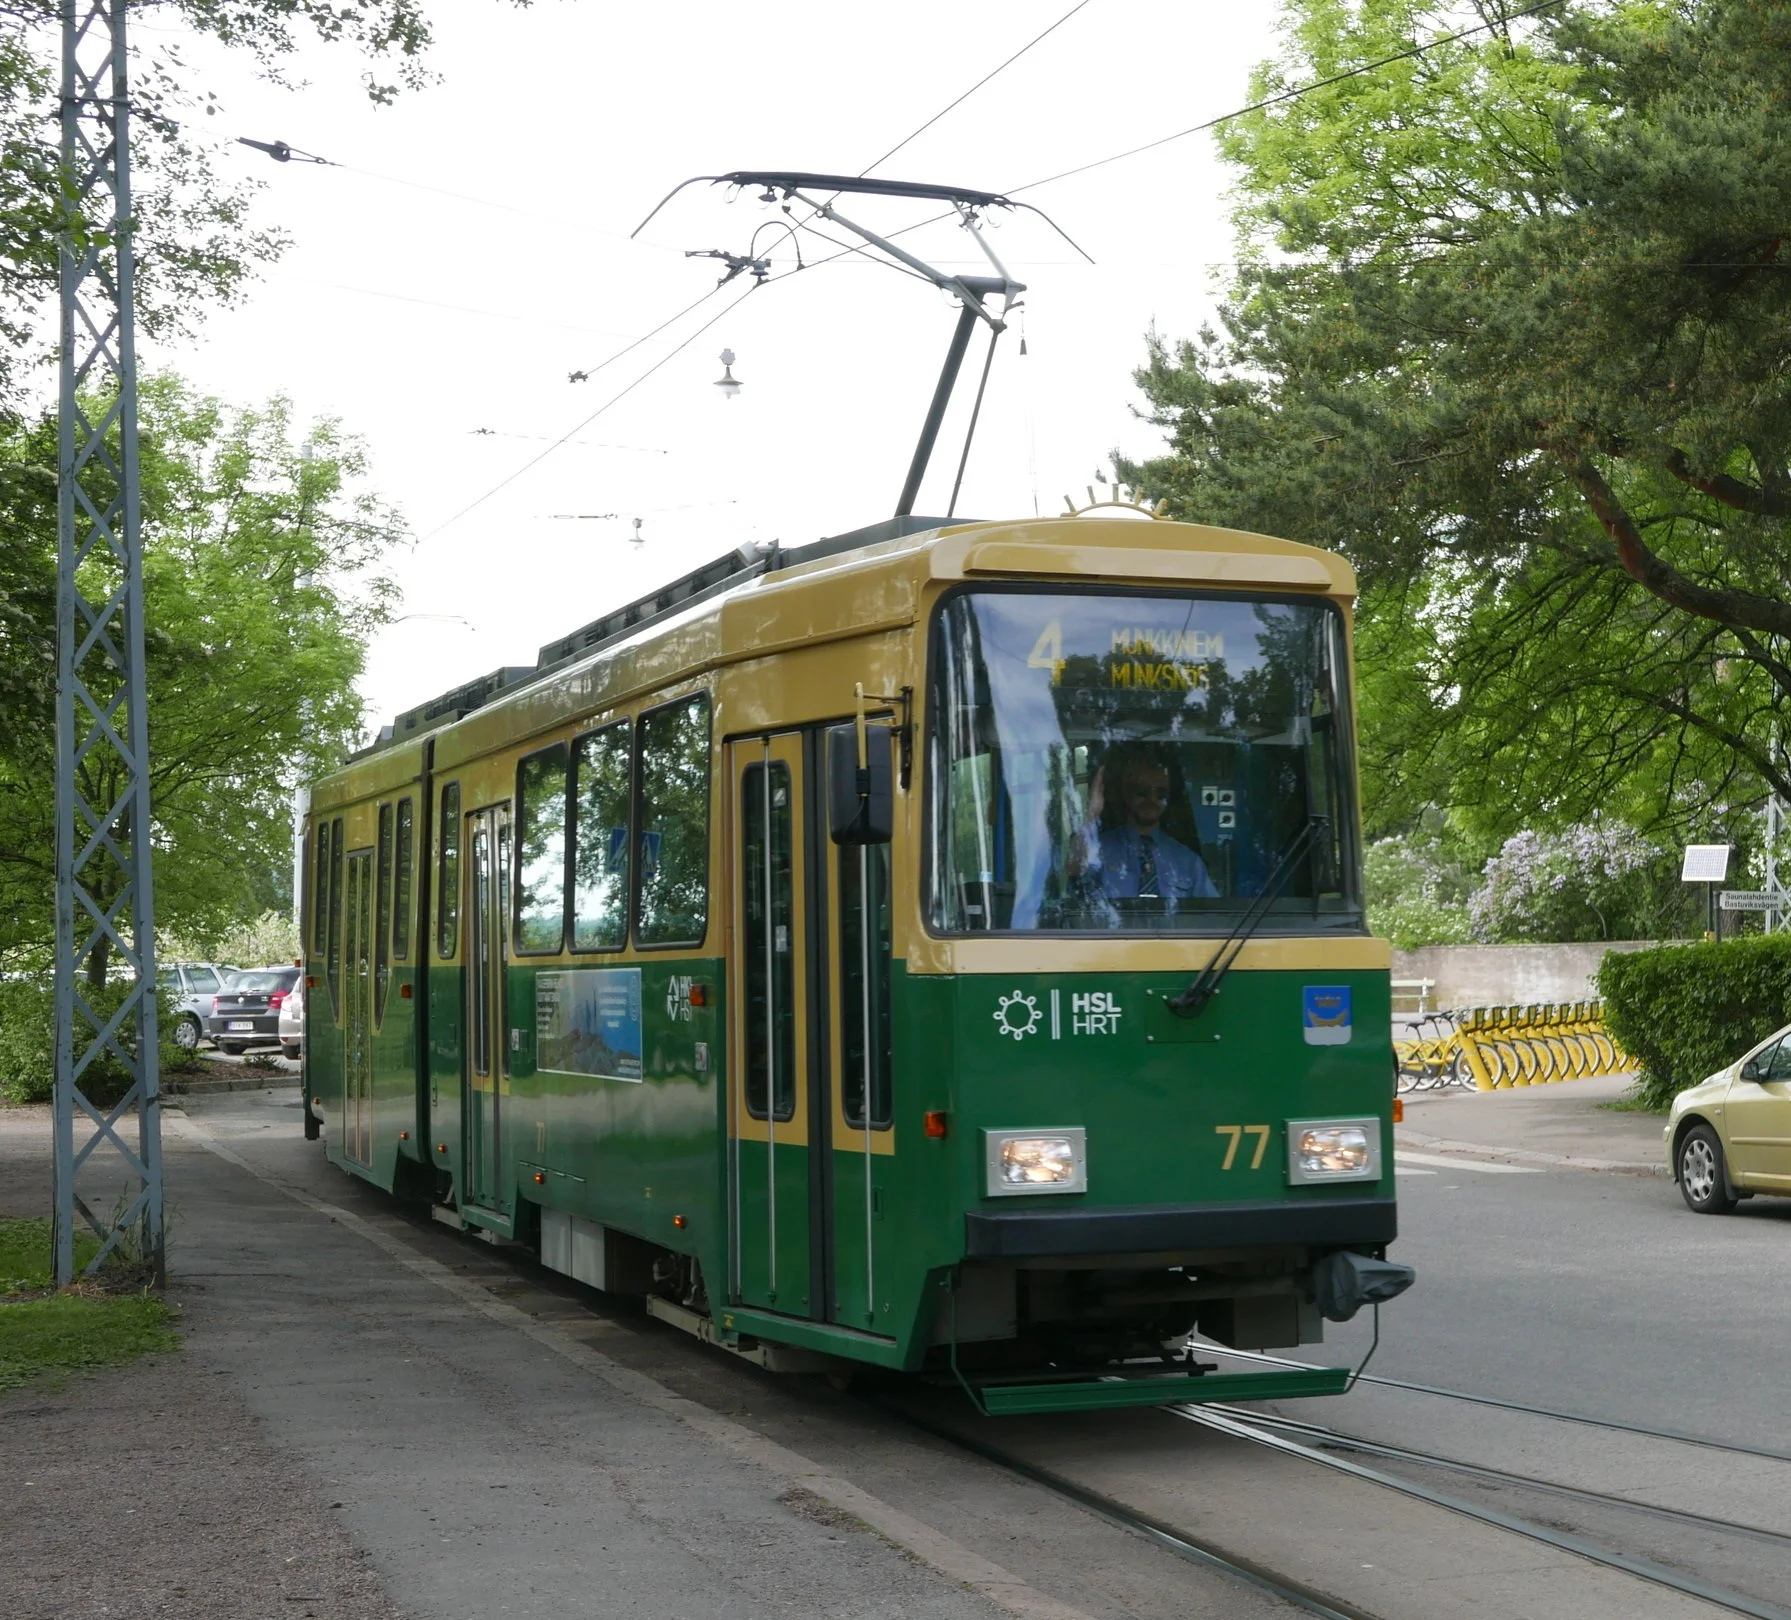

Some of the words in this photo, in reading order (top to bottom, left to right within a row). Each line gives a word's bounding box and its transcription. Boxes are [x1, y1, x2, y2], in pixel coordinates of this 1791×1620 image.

[1027, 617, 1067, 687] 4
[1724, 901, 1779, 909] Bastuviksvägen
[1725, 892, 1778, 901] Saunalahdentie
[1072, 992, 1122, 1013] HSL
[1073, 1014, 1122, 1035] HRT
[1215, 1125, 1270, 1170] 77
